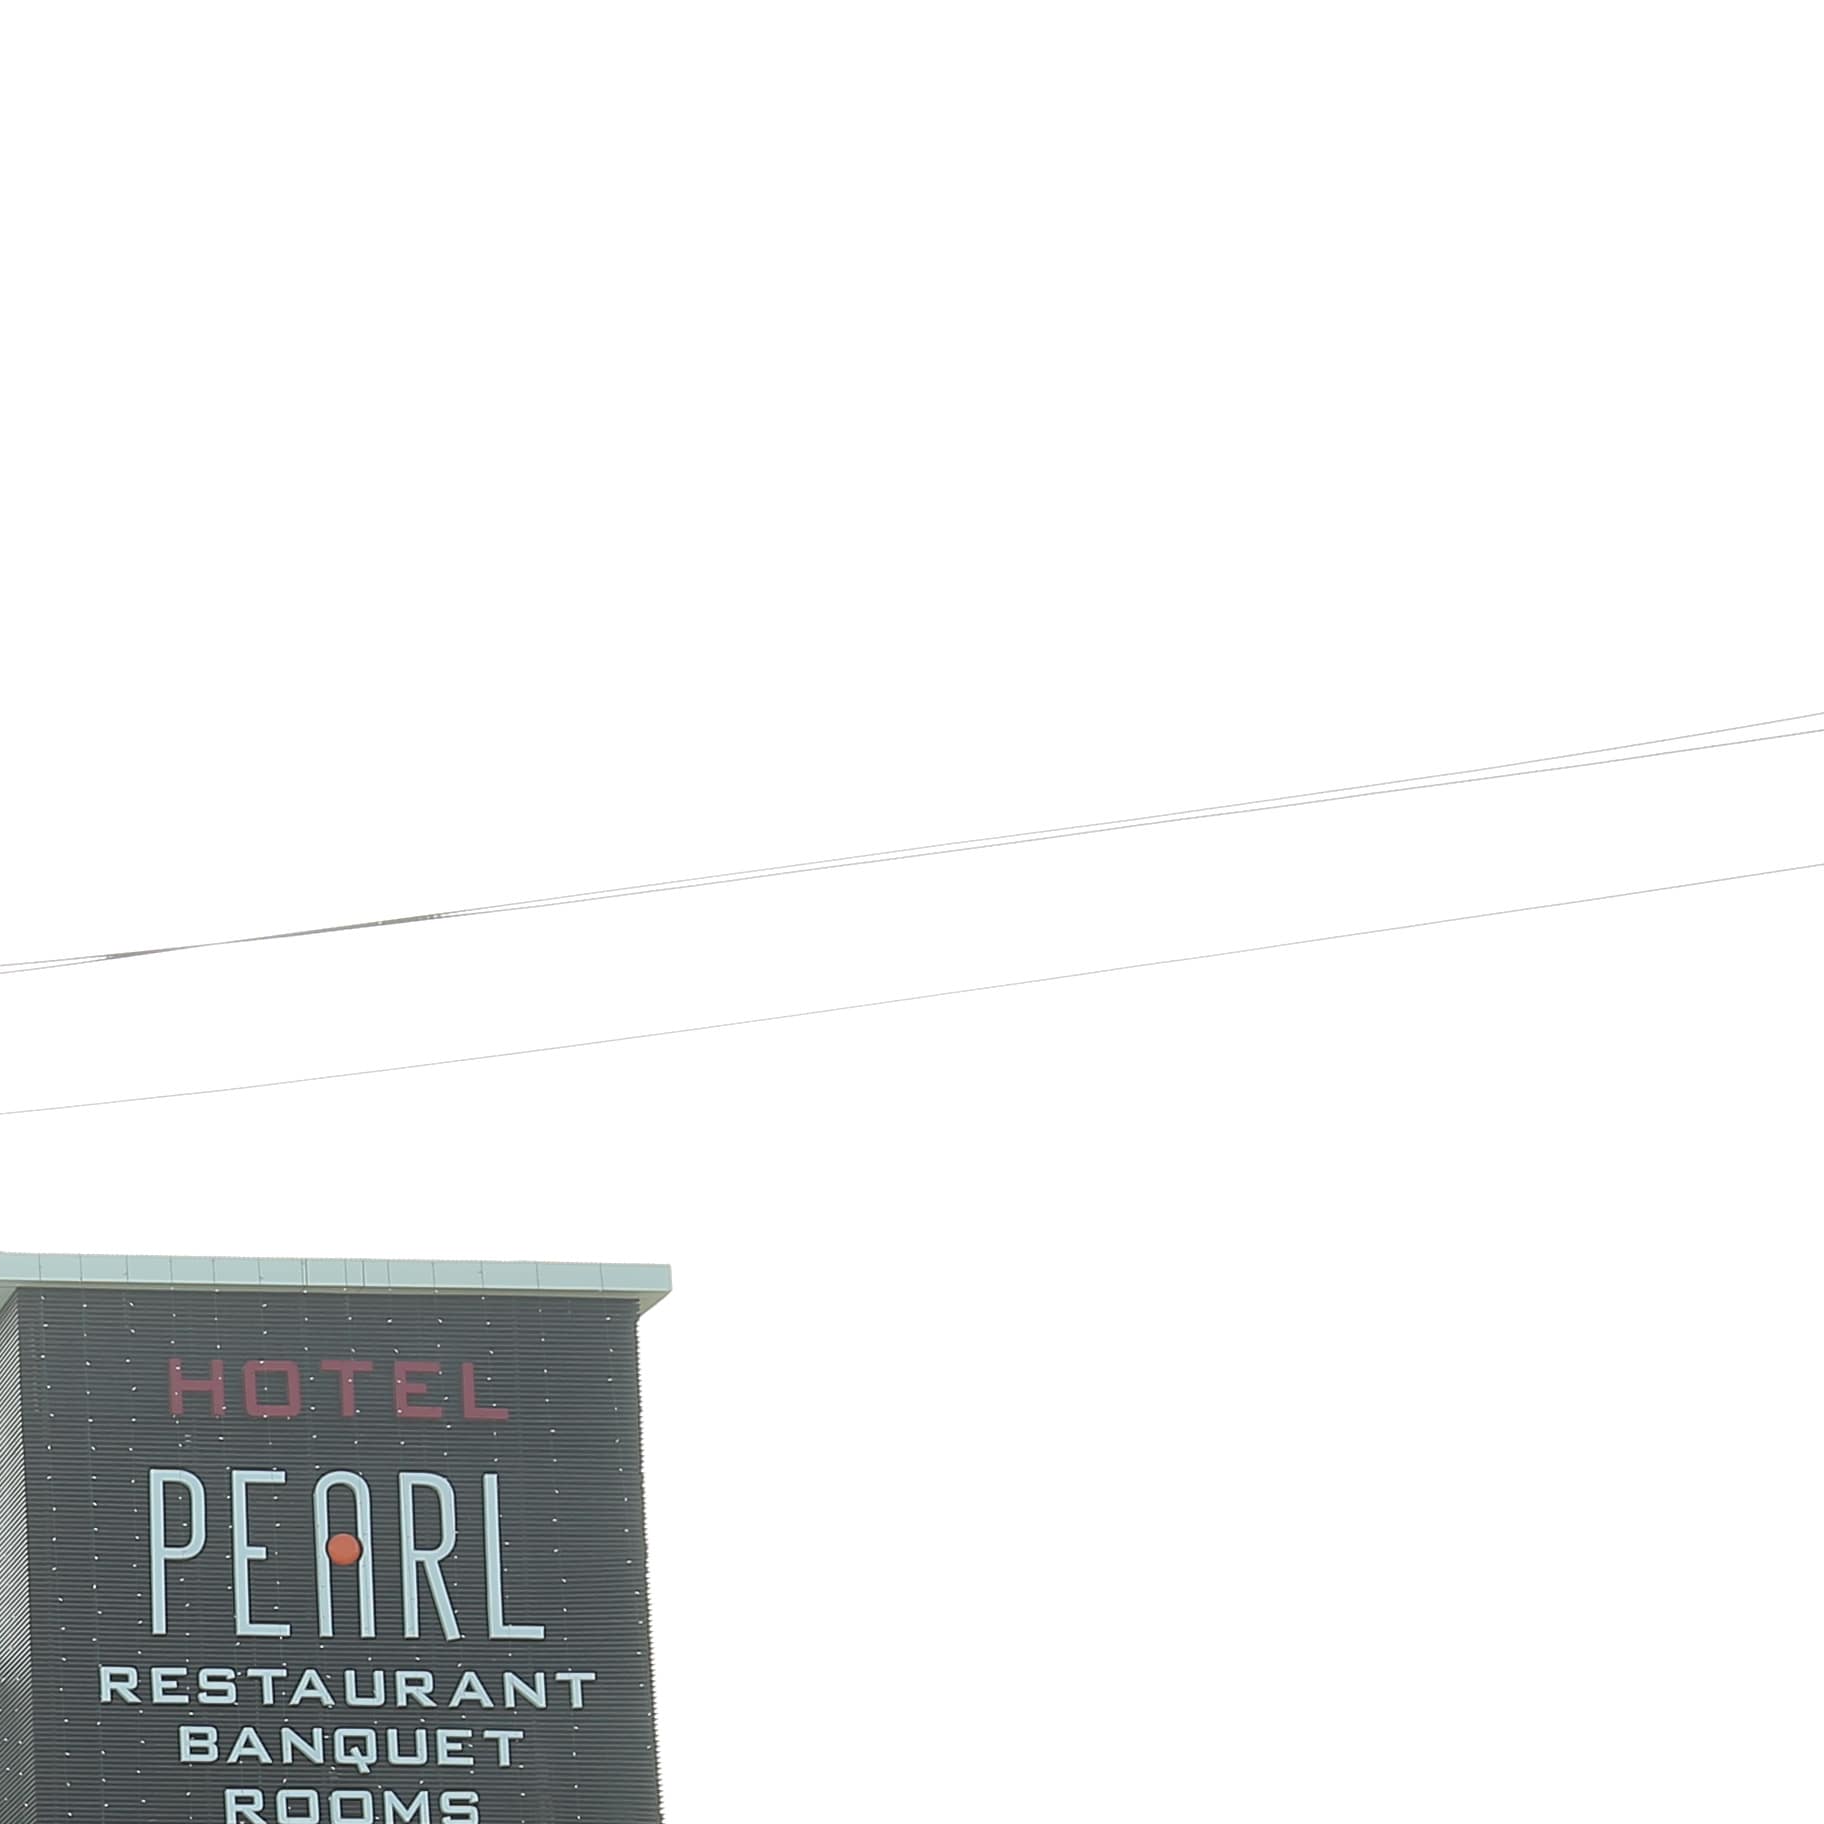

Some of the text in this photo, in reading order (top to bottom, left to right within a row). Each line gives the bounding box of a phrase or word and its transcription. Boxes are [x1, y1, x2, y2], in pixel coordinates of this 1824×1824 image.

[167, 1357, 510, 1420] HOTEL
[149, 1468, 545, 1641] PEARL
[98, 1665, 597, 1710] RESTAURANT
[178, 1725, 524, 1774] BANQUET
